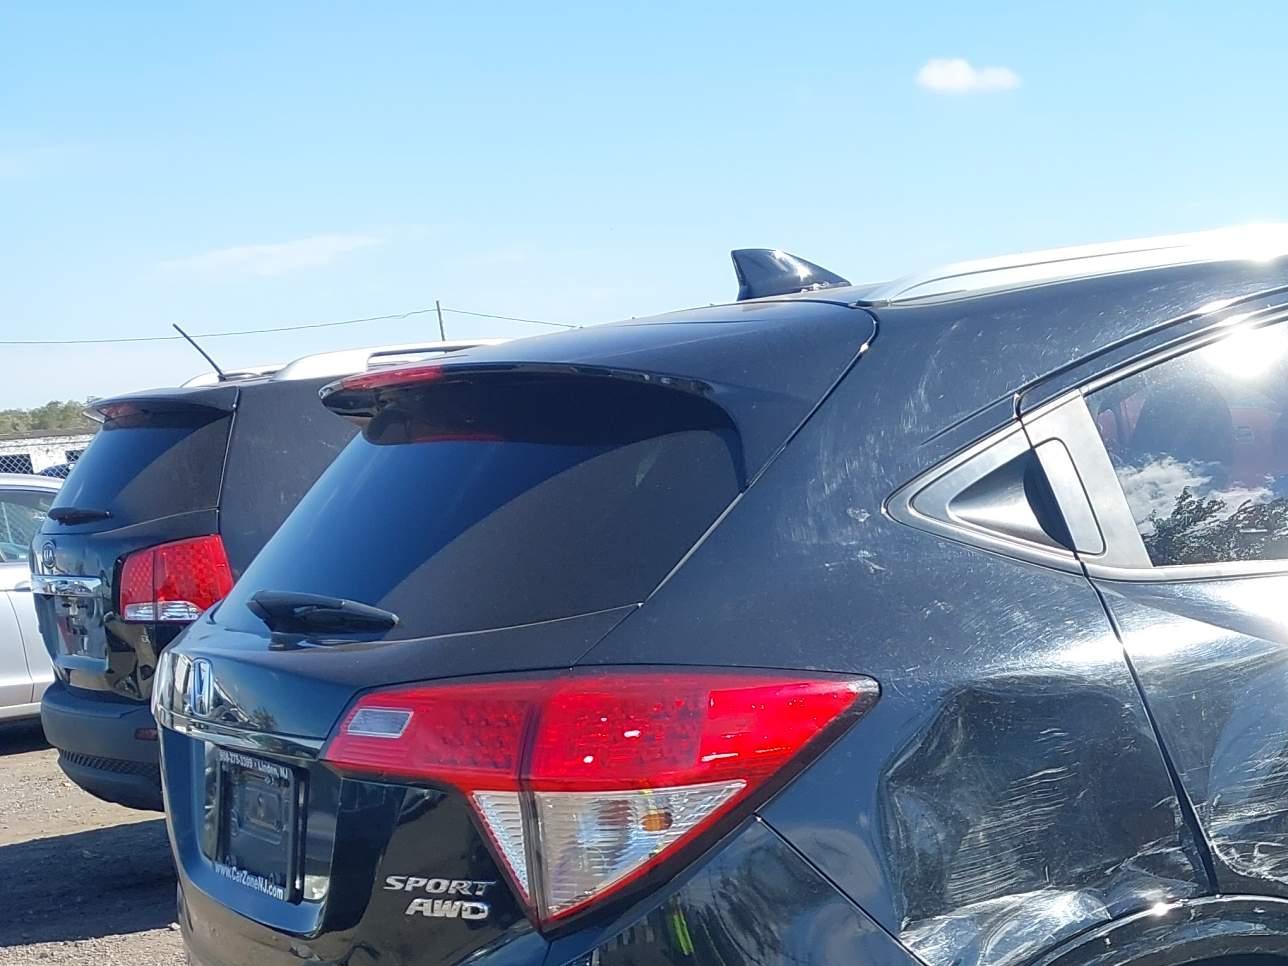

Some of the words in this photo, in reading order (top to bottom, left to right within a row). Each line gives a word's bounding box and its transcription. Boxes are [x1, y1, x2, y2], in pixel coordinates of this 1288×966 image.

[214, 862, 284, 900] www.CarZoneNJ.com
[383, 875, 497, 895] SPORT
[405, 898, 489, 920] AWD
